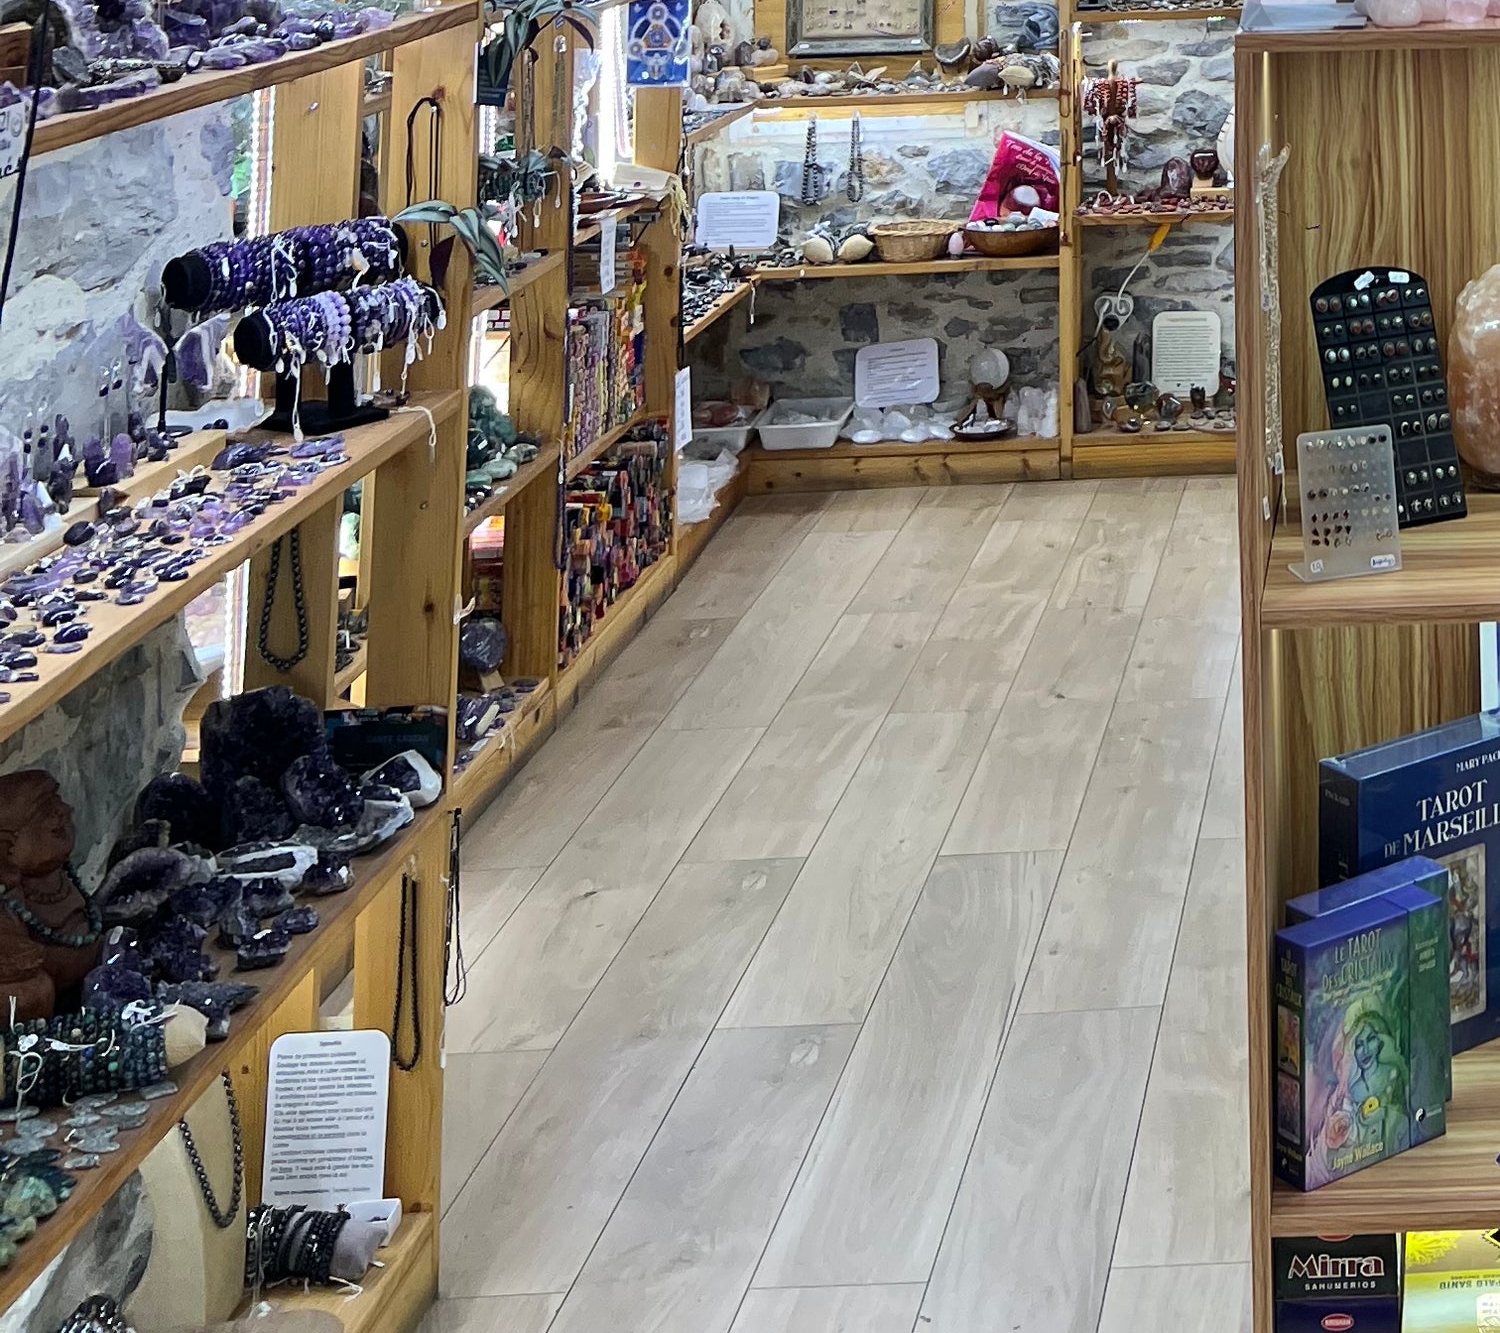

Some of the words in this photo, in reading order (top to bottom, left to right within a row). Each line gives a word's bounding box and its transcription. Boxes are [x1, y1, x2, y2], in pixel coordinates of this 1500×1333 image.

[1456, 756, 1480, 773] MARY
[1416, 779, 1488, 822] TAROT
[1384, 839, 1400, 858] DE
[1335, 946, 1345, 963] LE
[1347, 928, 1381, 959] TAROT
[1332, 1152, 1353, 1171] Jayne
[1354, 1142, 1384, 1162] Wallace
[1288, 1253, 1385, 1280] Mirra
[1304, 1281, 1376, 1291] SAHUMERIOS
[1439, 1280, 1472, 1290] SANTO
